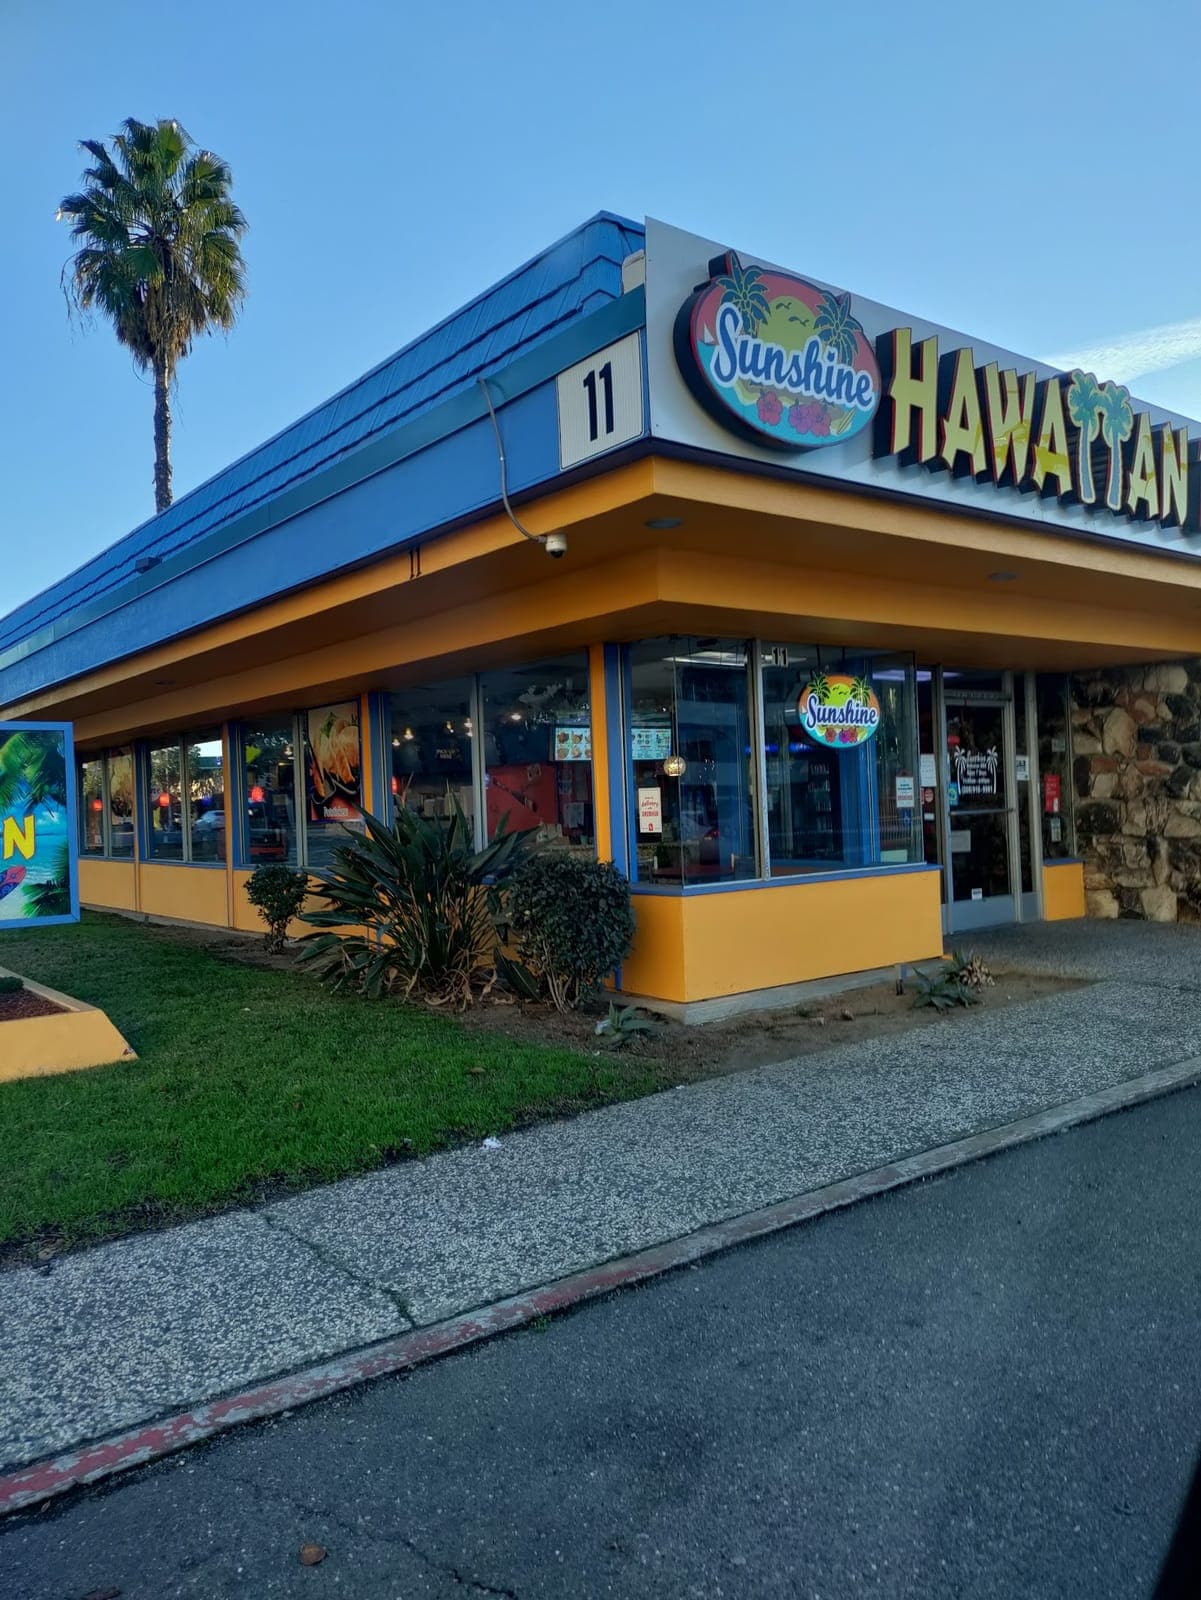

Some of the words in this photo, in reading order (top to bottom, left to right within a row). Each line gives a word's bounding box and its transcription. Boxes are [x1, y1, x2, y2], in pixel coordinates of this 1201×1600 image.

[712, 303, 873, 408] Sunshine
[582, 361, 615, 442] 11
[772, 647, 788, 666] 11
[806, 695, 878, 728] Sunshine
[3, 814, 36, 860] N
